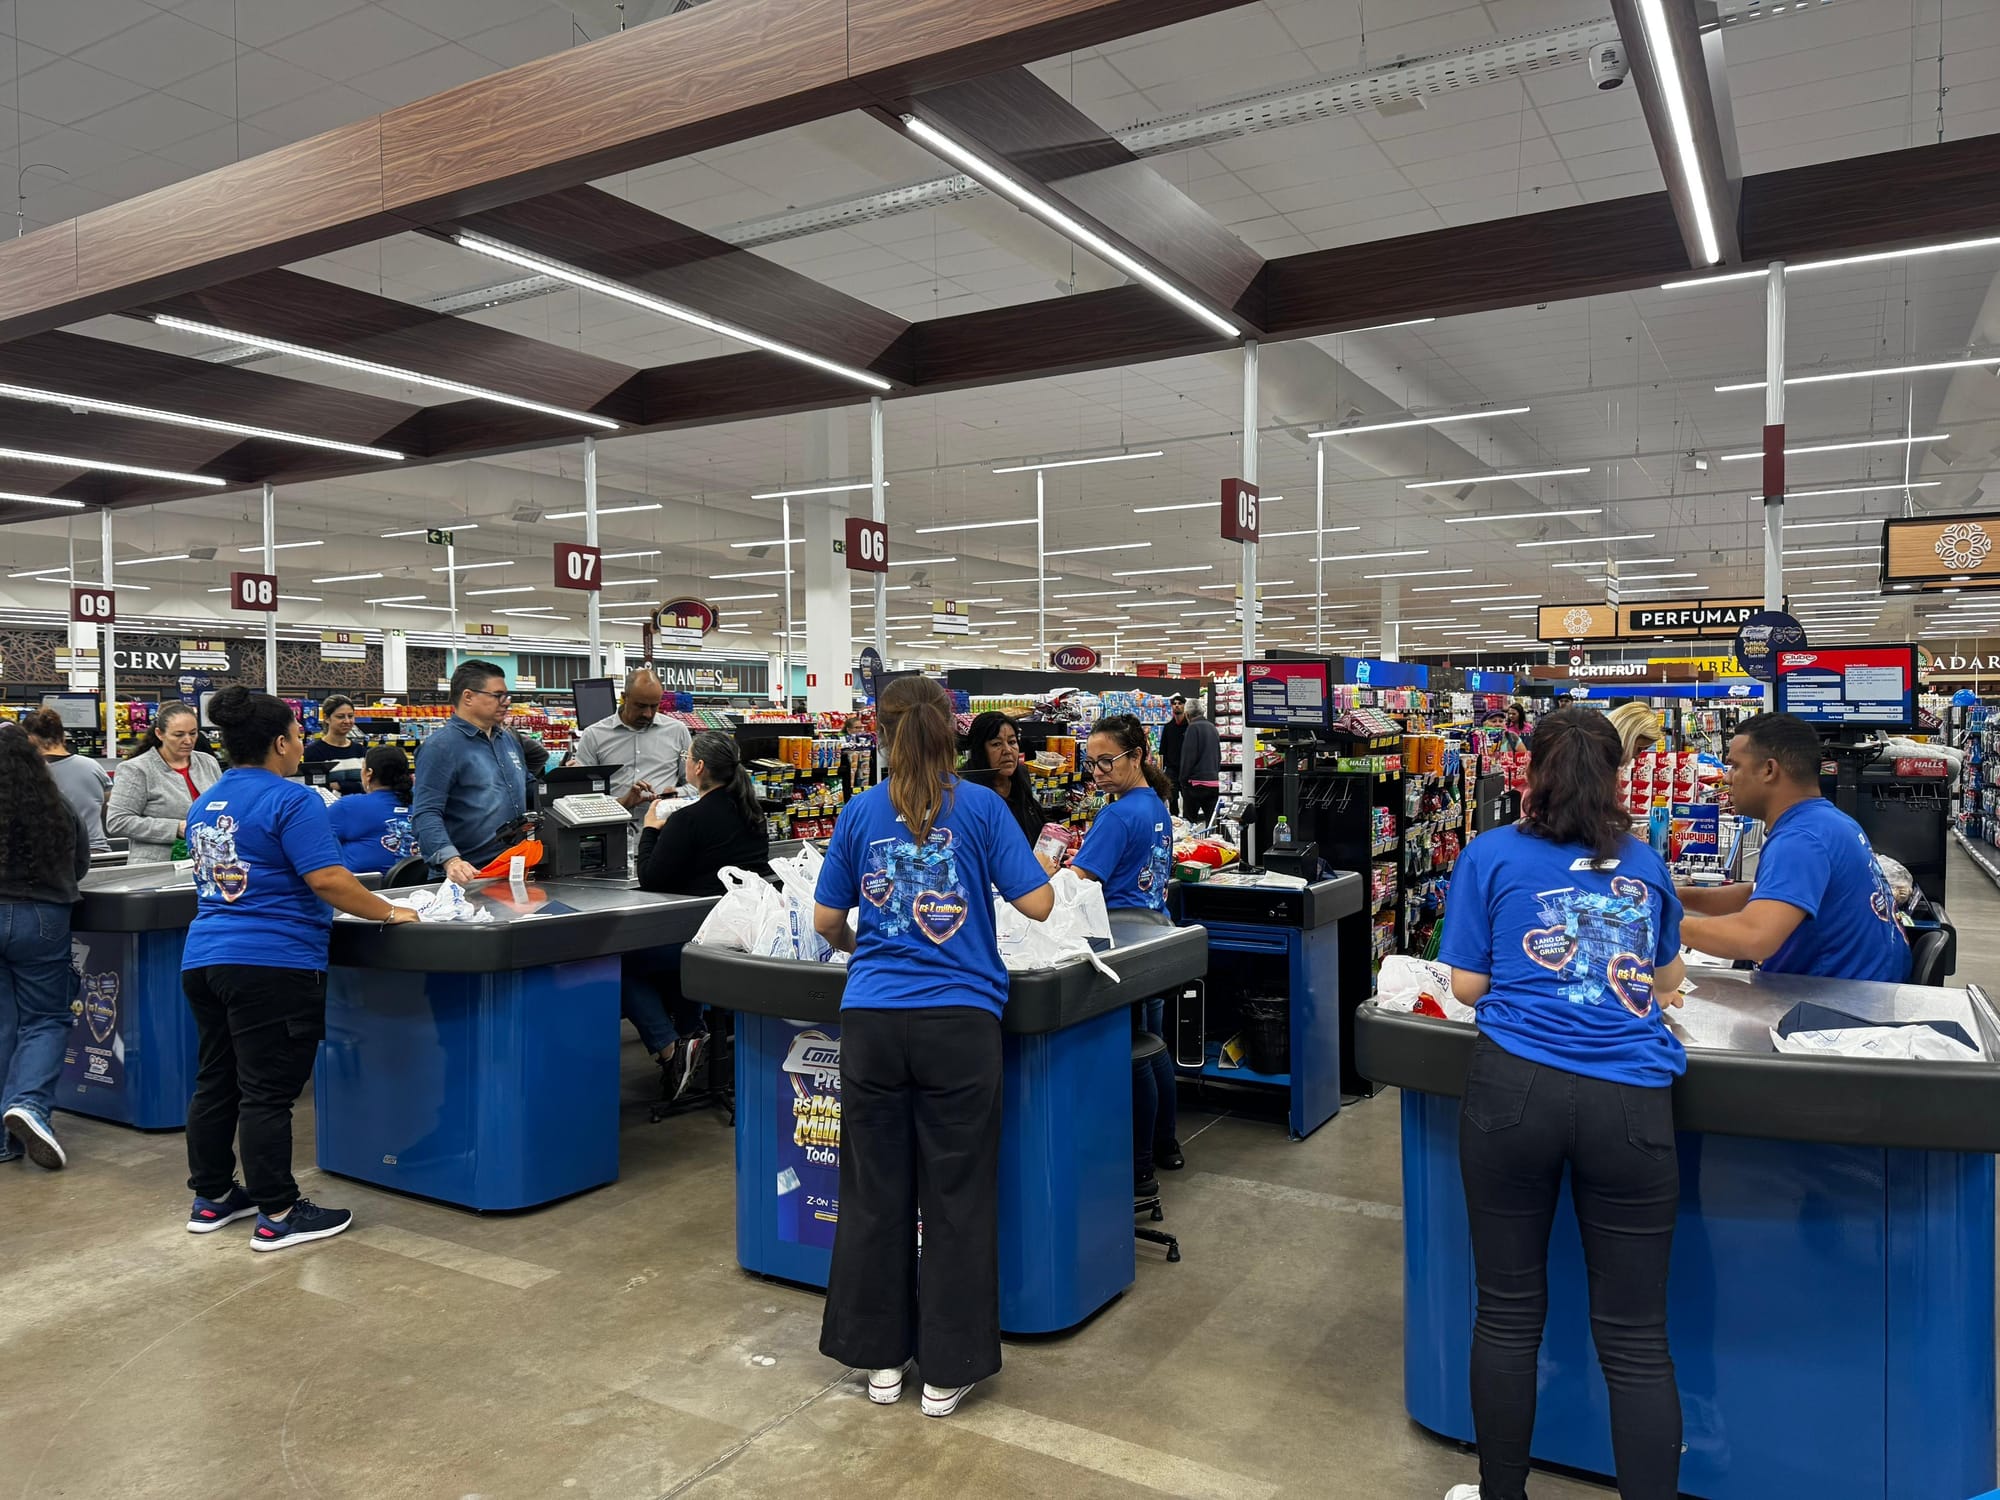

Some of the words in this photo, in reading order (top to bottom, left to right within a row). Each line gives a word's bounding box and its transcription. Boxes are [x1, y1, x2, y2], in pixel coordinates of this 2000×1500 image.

[1237, 490, 1257, 530] 05
[860, 528, 885, 562] 06
[567, 551, 596, 581] 07
[242, 578, 273, 604] 08
[79, 594, 111, 617] 09
[946, 602, 955, 613] 09
[678, 617, 686, 627] 11
[482, 625, 492, 634] 13
[338, 633, 348, 642] 15
[198, 642, 208, 650] 17
[113, 650, 230, 672] CERVS
[1060, 652, 1090, 667] Doces
[1351, 720, 1370, 737] HALLS
[1349, 759, 1371, 767] HALLS
[1914, 761, 1945, 769] HALLS
[1675, 832, 1716, 844] Brilhante
[930, 901, 936, 913] 1
[936, 904, 963, 914] milhão
[1539, 937, 1554, 945] ANO
[1539, 946, 1566, 956] GRÁTIS
[1630, 967, 1637, 981] 1
[793, 1097, 811, 1114] R$
[805, 1146, 836, 1164] Todo
[806, 1195, 829, 1207] Z-ON
